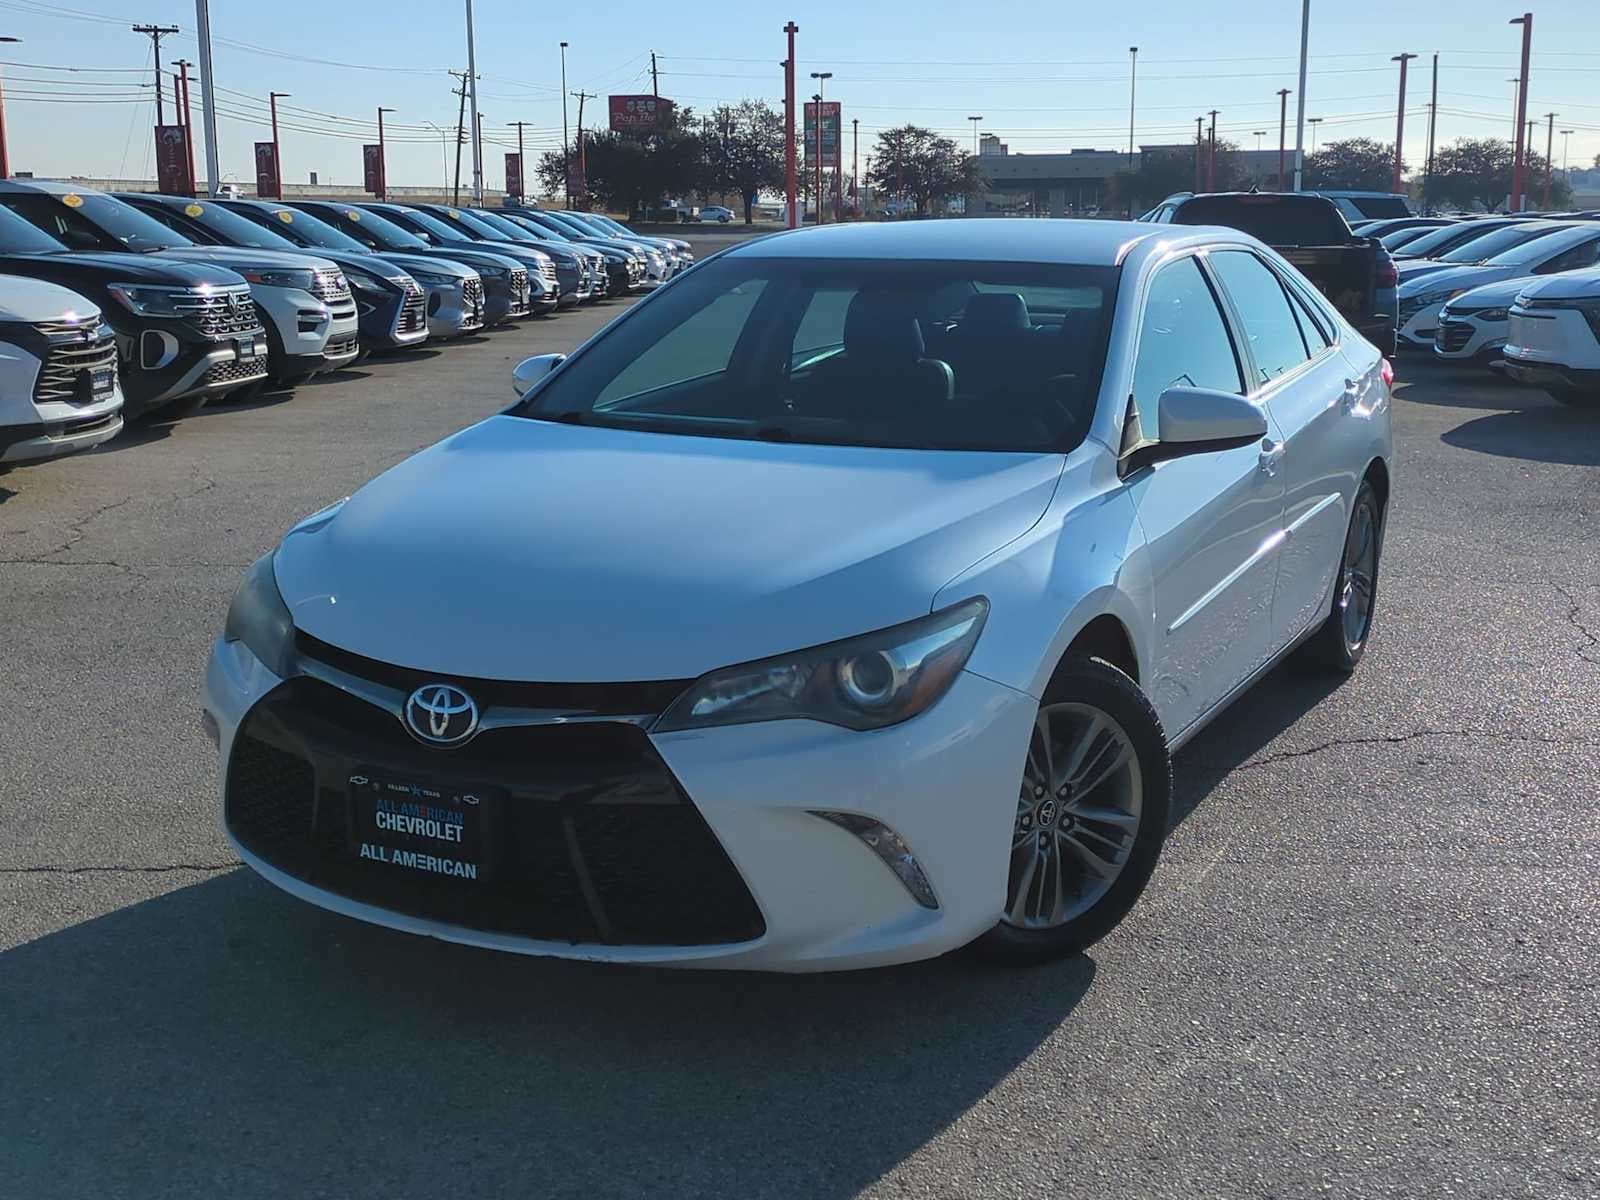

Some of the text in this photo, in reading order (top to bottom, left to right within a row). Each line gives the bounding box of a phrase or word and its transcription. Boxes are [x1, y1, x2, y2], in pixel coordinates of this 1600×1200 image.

[375, 811, 464, 842] CHEVROLET
[376, 799, 464, 824] ALL AMERICAN
[360, 843, 477, 879] ALL AMERICAN
